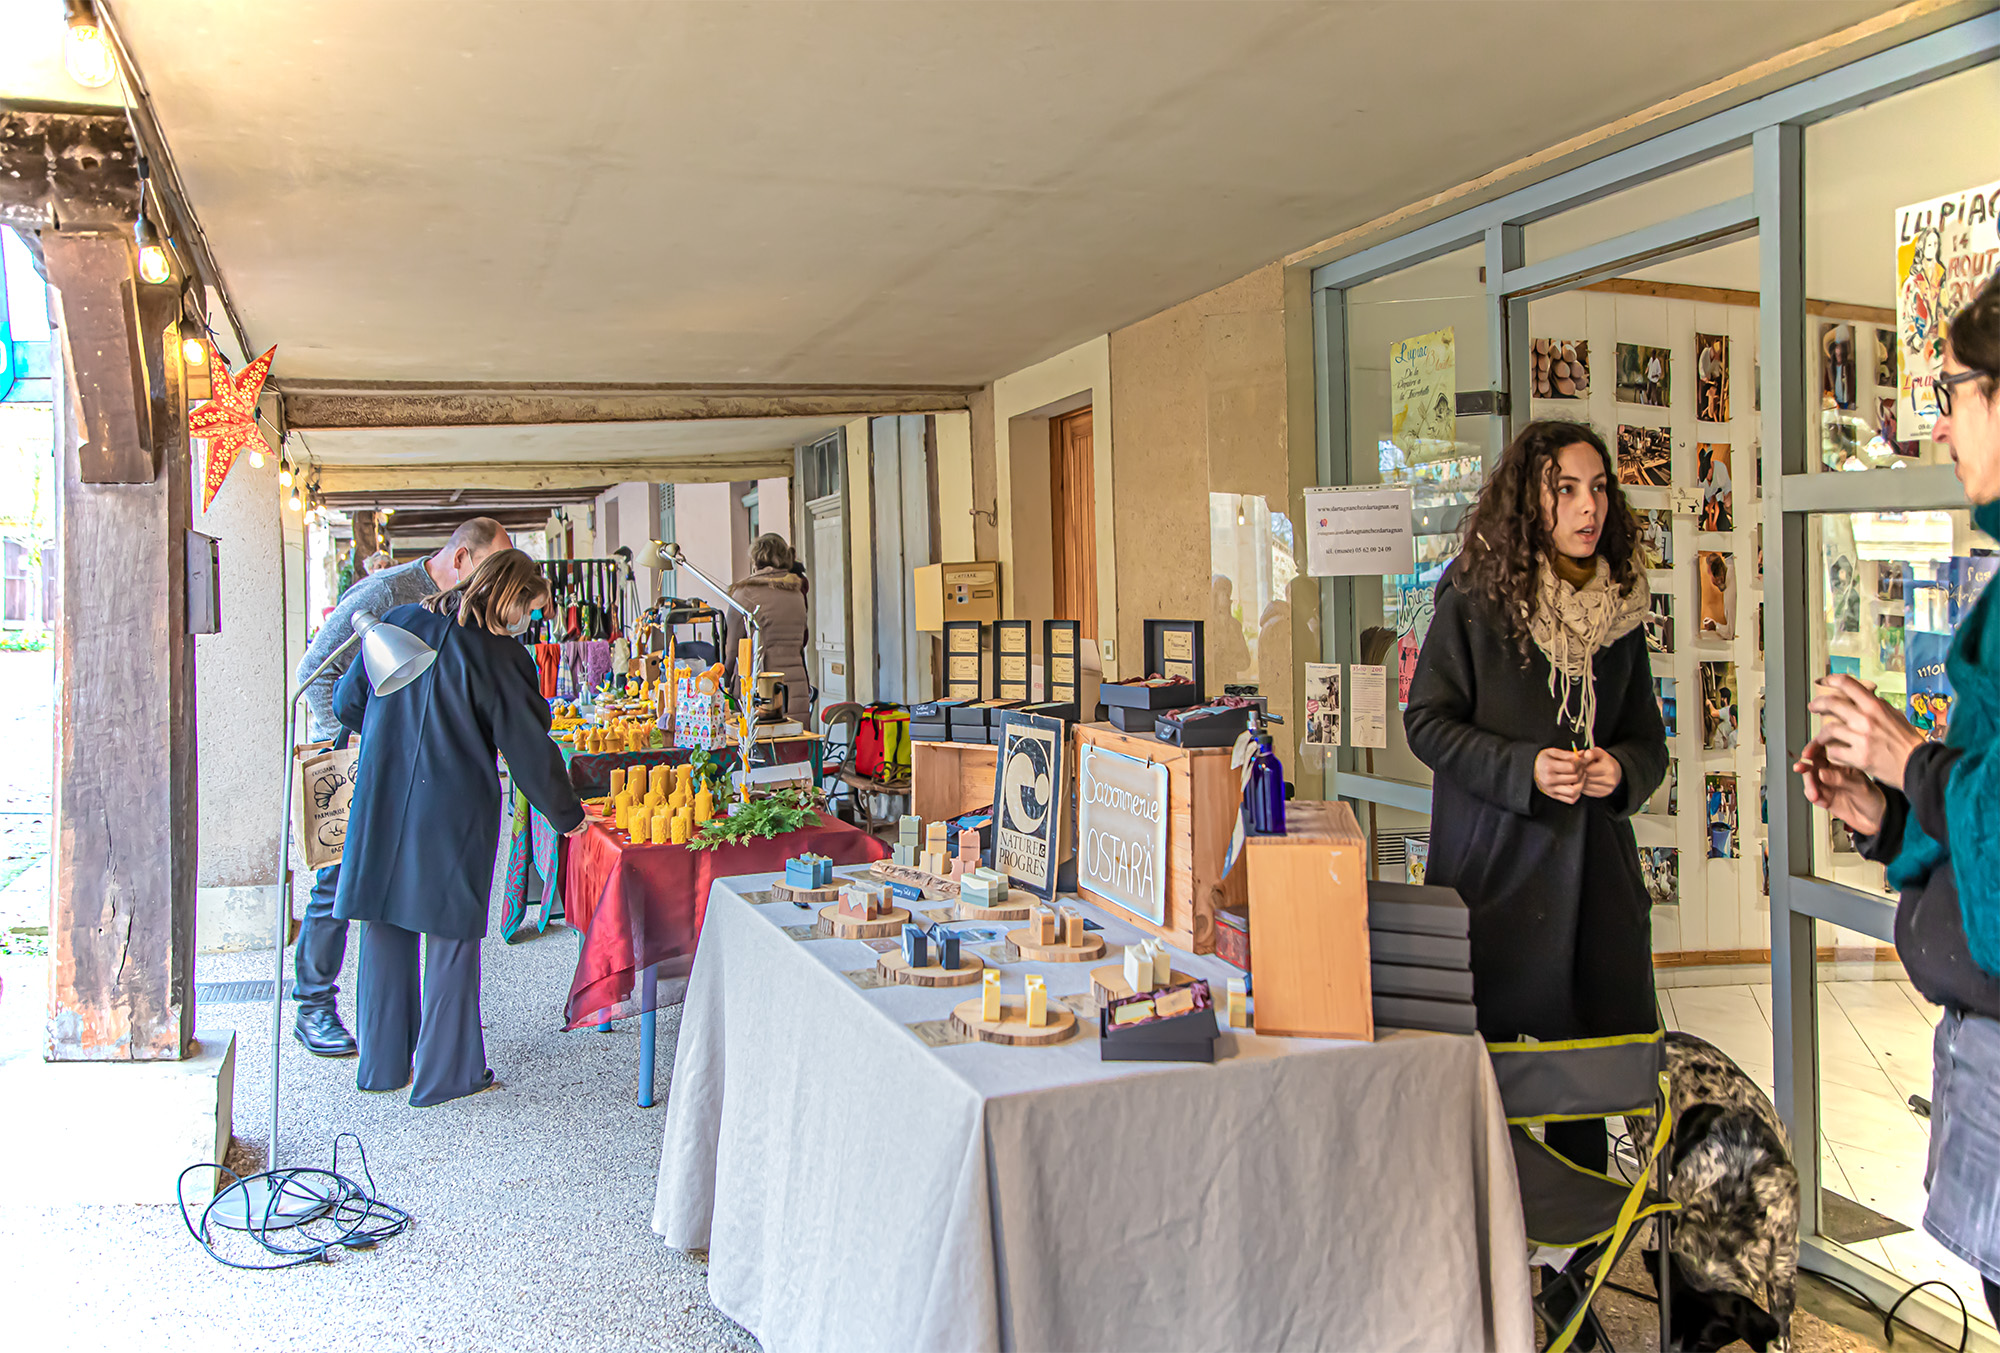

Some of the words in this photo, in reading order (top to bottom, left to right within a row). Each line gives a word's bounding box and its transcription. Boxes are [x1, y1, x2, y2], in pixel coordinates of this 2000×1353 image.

[1394, 342, 1428, 367] Lupiac
[1083, 755, 1160, 823] Savonnerie
[1000, 831, 1039, 856] NATURE
